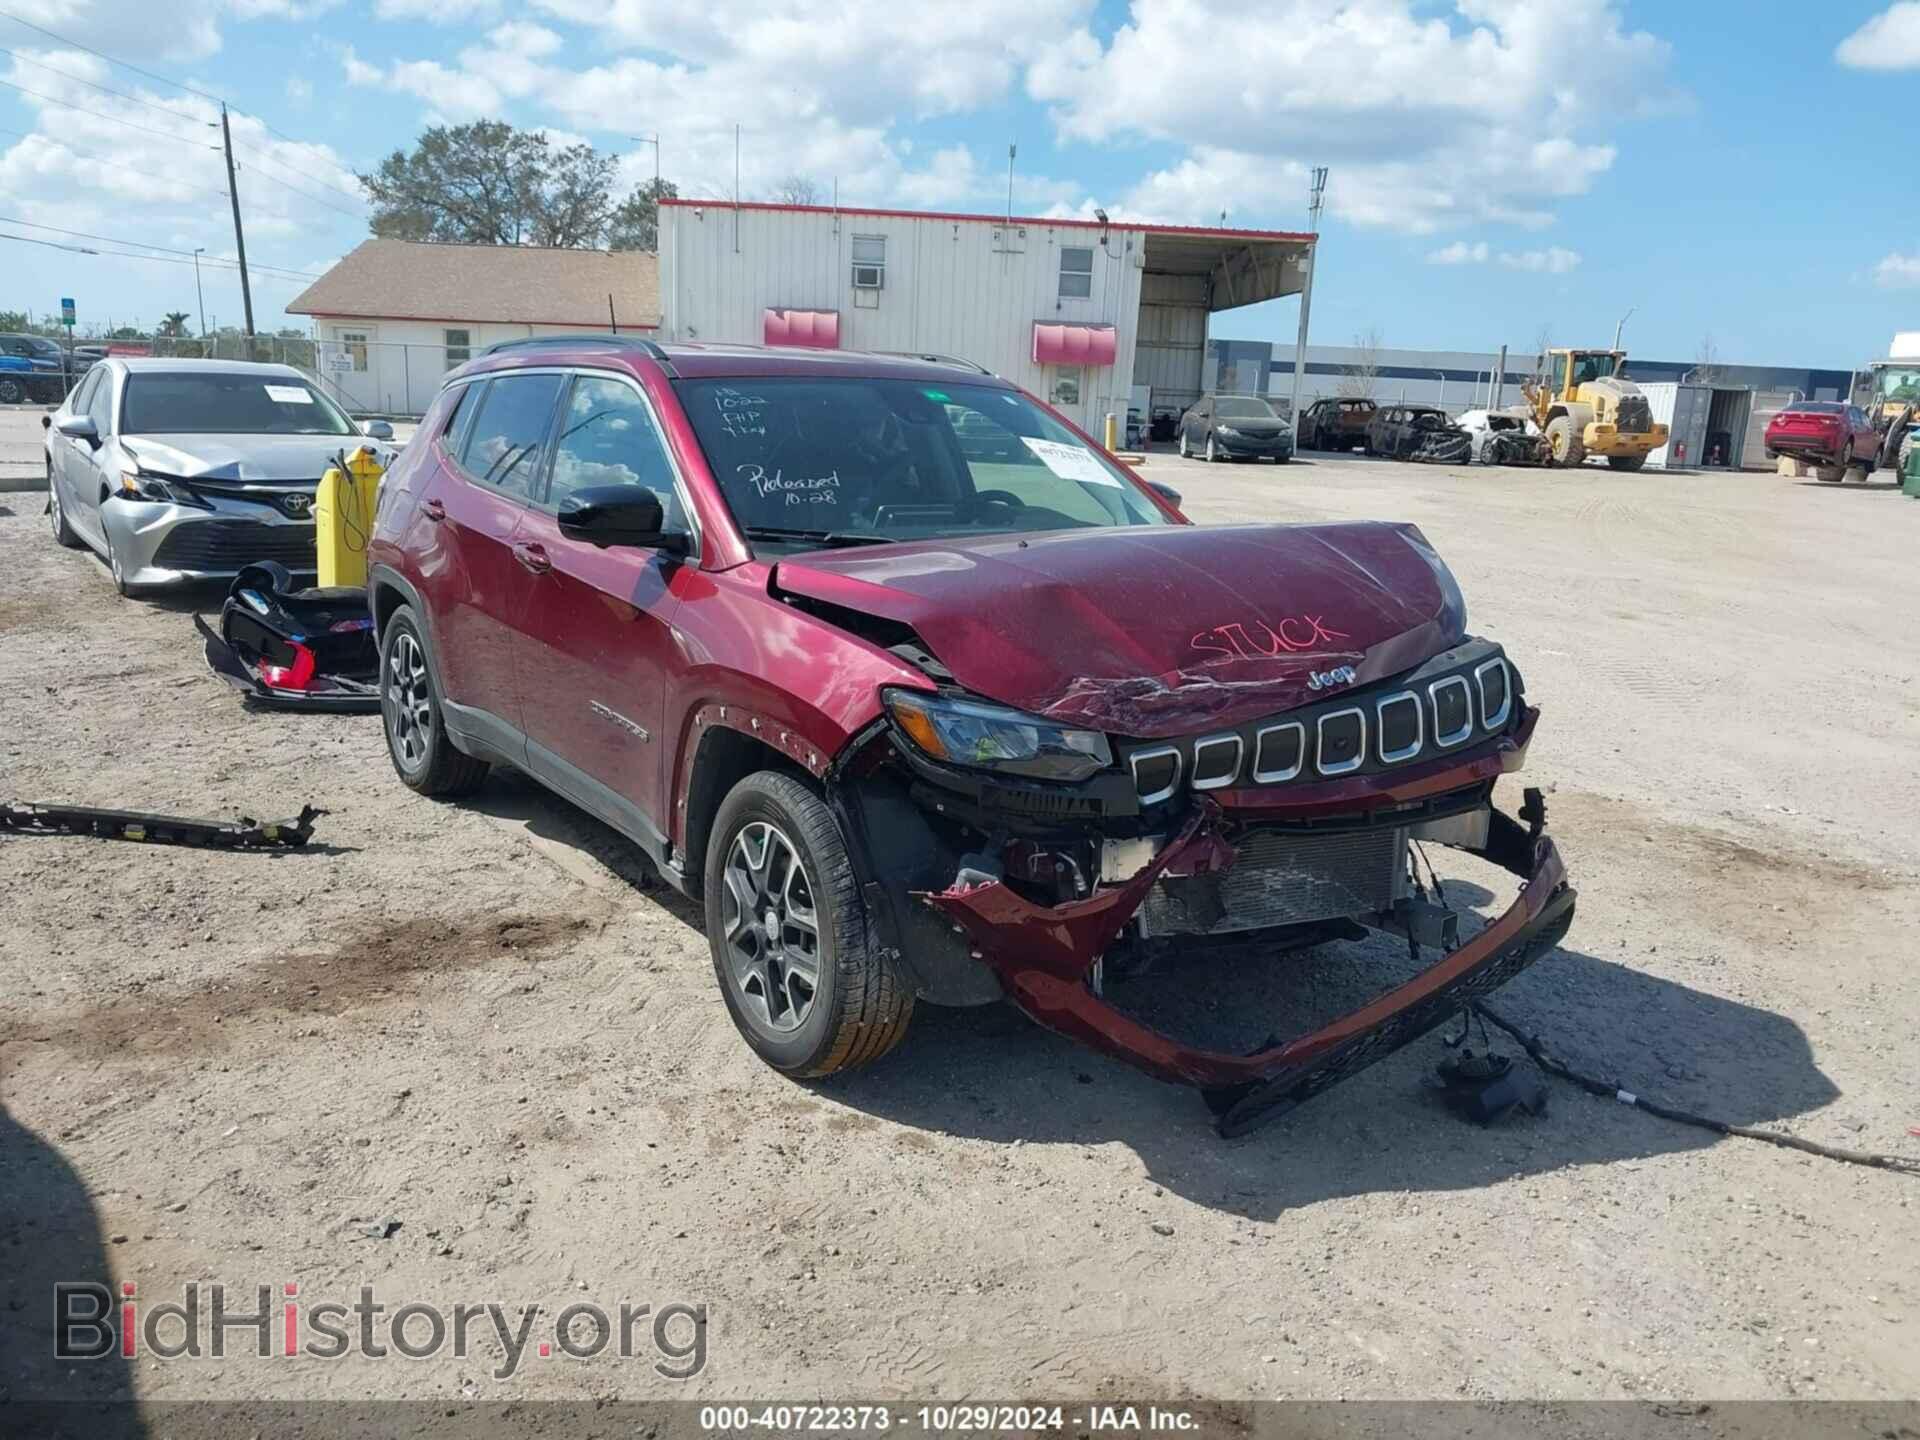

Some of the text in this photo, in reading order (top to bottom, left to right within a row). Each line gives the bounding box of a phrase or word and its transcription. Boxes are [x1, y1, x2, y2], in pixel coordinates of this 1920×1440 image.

[736, 463, 841, 498] Released
[785, 489, 838, 506] 10-28
[1190, 615, 1351, 666] STUCK
[1306, 664, 1357, 692] Jeep
